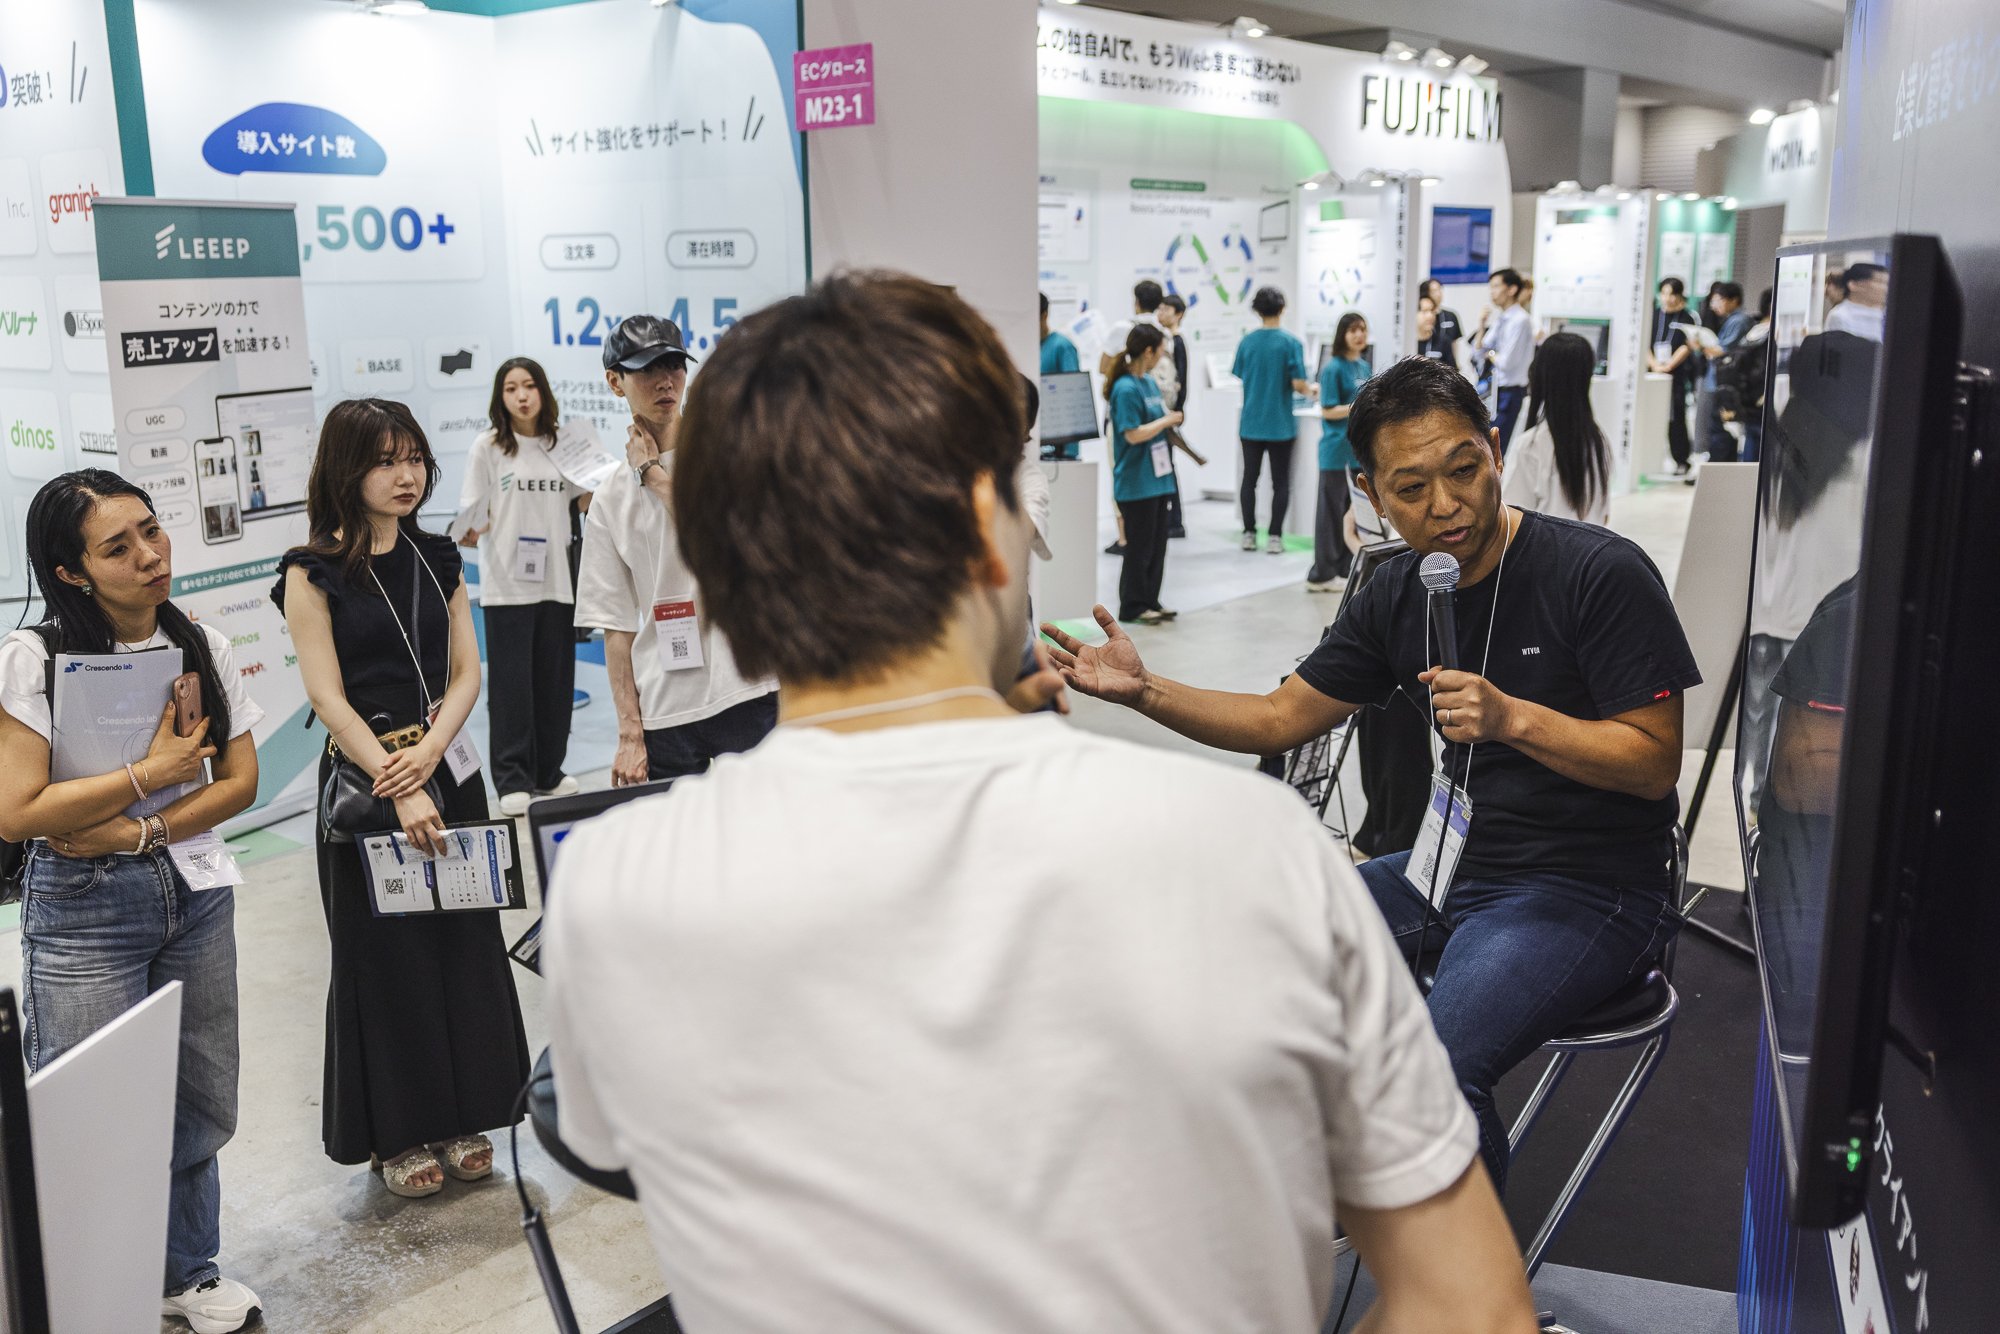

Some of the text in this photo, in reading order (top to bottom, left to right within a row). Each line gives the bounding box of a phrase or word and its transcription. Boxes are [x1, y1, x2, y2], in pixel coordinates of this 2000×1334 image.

[801, 58, 866, 82] ECグロース
[805, 94, 863, 124] M23-1
[1360, 75, 1503, 143] FUJIFILM
[237, 130, 356, 158] 導入サイト数
[178, 238, 250, 260] LEEEP
[686, 240, 735, 258] 滞在時間
[159, 300, 260, 320] コンテンツの力で
[125, 332, 216, 361] 売上アップ
[367, 358, 402, 374] BASE
[145, 414, 166, 426] UGC
[10, 420, 55, 451] dinos
[151, 447, 168, 459] 動画
[157, 511, 182, 524] ビュー
[231, 631, 260, 647] dinos
[85, 661, 133, 672] Crescendo lab
[97, 713, 158, 725] Crescendo lab
